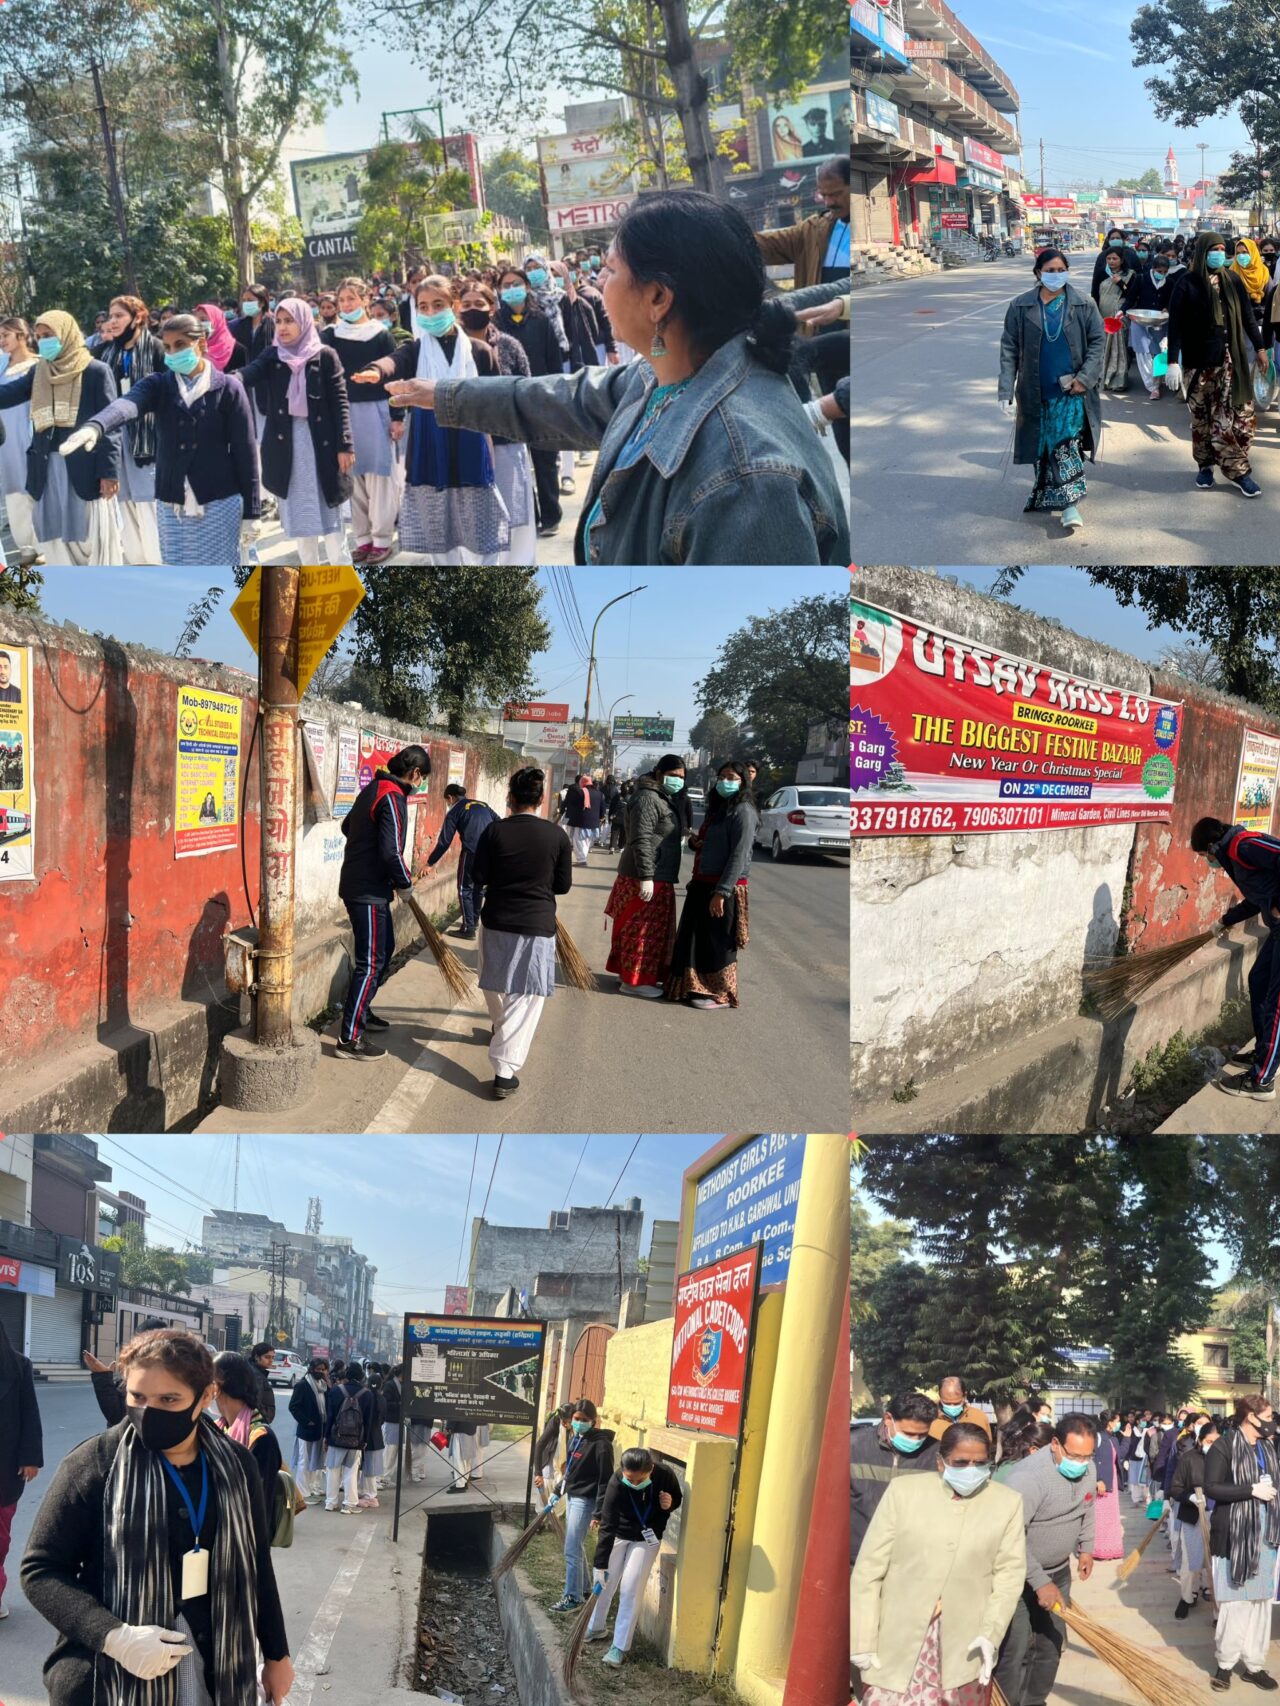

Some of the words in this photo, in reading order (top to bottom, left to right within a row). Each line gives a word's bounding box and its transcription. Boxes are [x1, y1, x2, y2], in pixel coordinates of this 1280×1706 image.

[557, 201, 629, 228] METRO
[912, 628, 1041, 698] UTSAV
[1017, 706, 1054, 724] BRINGS
[1055, 714, 1095, 732] ROORKEE
[858, 741, 885, 756] Garg
[911, 713, 955, 746] THE
[960, 719, 1042, 755] BIGGEST
[1045, 733, 1098, 762] FESTIVE
[1101, 742, 1142, 766] BAZAAR
[855, 756, 882, 772] Garg
[950, 752, 986, 770] New
[990, 757, 1019, 773] Year
[1022, 760, 1038, 774] Or
[1041, 761, 1091, 777] Christmas
[1093, 767, 1123, 781] Special
[1003, 782, 1020, 795] ON
[1023, 783, 1040, 795] 25th
[1041, 783, 1089, 796] DECEMBER
[963, 806, 1043, 827] 7906307101
[1051, 808, 1078, 821] Mineral
[1078, 807, 1102, 821] Garden,
[1103, 807, 1117, 819] Civil
[1117, 808, 1130, 819] Lines
[697, 1158, 740, 1206] METHODIST
[740, 1138, 768, 1176] GIRLS
[726, 1157, 786, 1211] ROORKEE
[692, 1224, 719, 1252] AFFILIATED
[747, 1190, 782, 1225] GARHWAL
[678, 1277, 698, 1308] राष्ट्रीय
[698, 1277, 715, 1302] छात्र
[715, 1266, 732, 1295] सेना
[733, 1262, 751, 1292] दल
[672, 1305, 703, 1370] NATIONAL
[704, 1300, 727, 1328] CADET
[726, 1304, 747, 1354] CORPS
